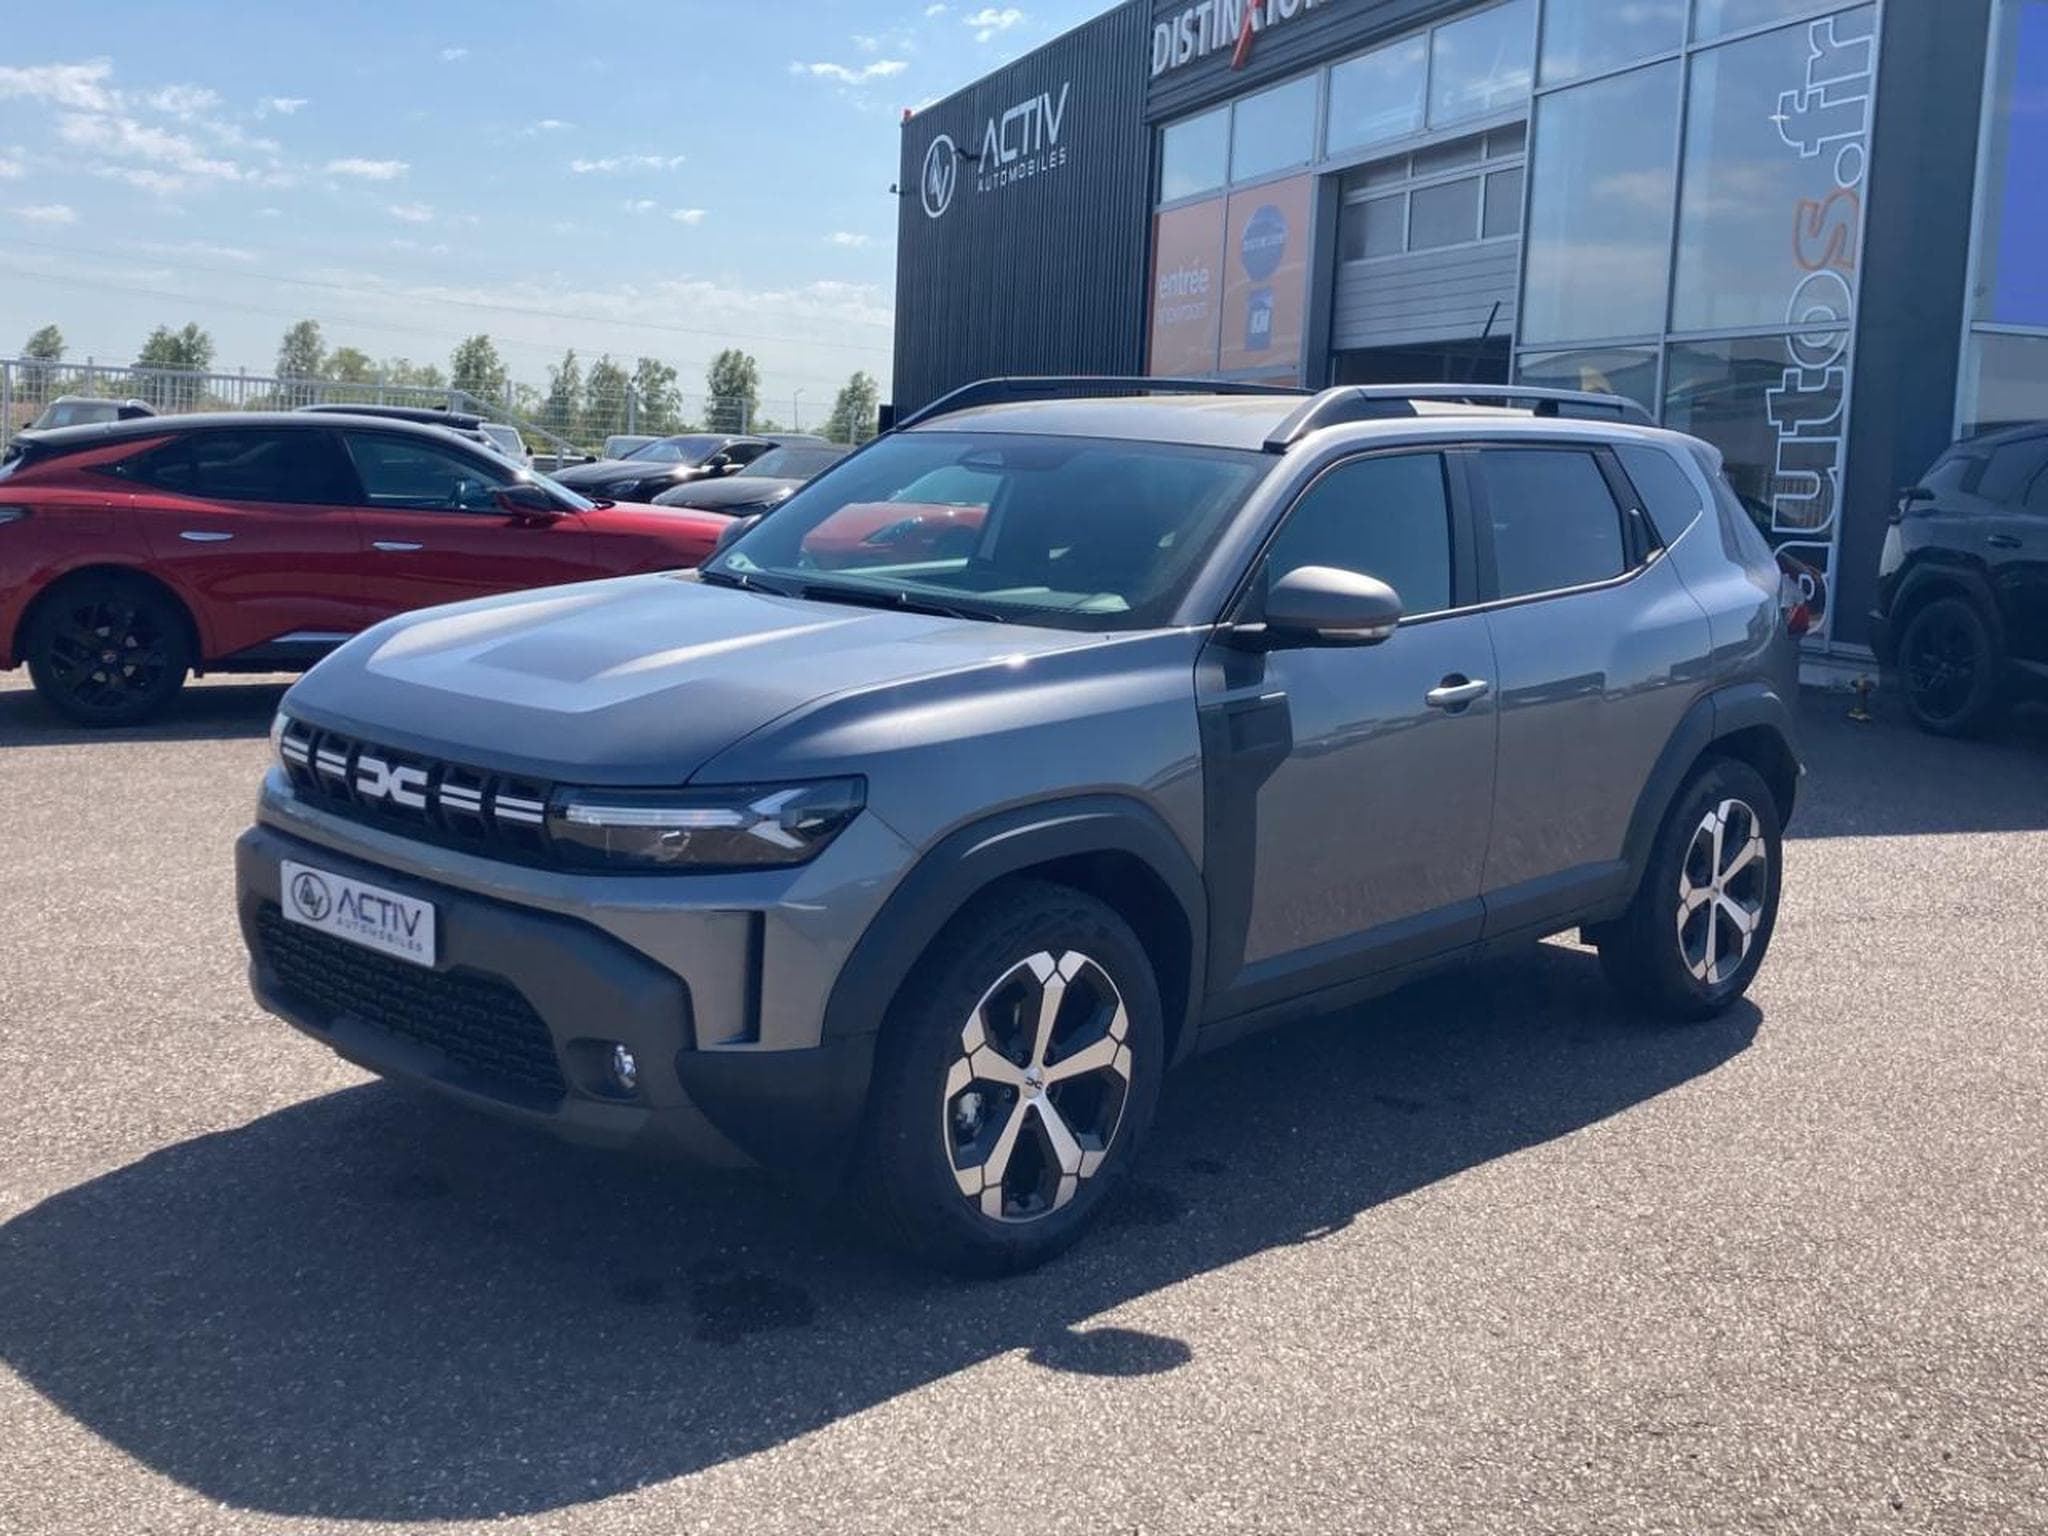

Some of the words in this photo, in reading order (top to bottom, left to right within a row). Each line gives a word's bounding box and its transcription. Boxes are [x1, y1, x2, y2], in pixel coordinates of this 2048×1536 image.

[978, 81, 1069, 173] ACTIV
[977, 146, 1067, 192] AUTOMOBILES
[337, 887, 422, 937] ACTIV
